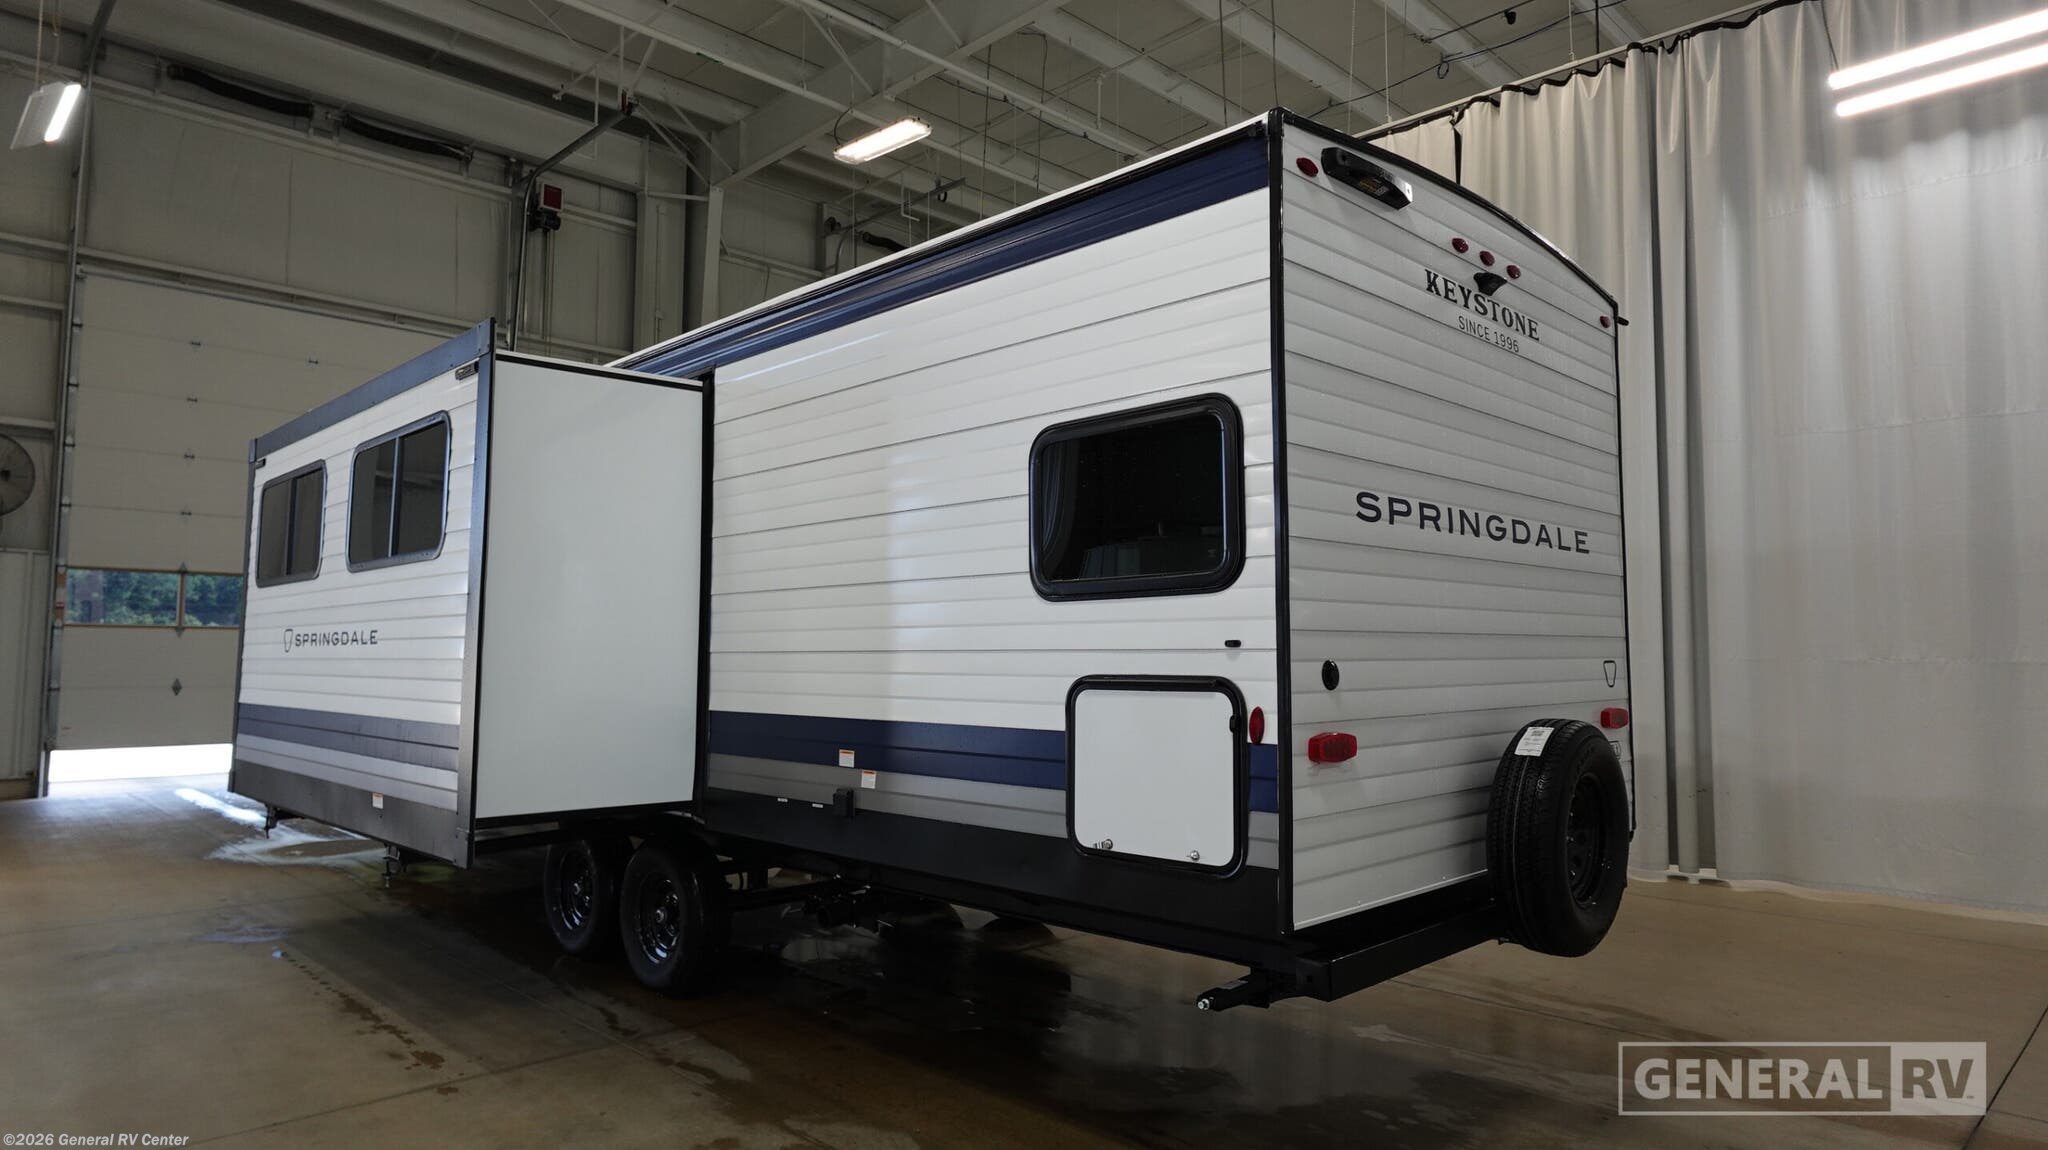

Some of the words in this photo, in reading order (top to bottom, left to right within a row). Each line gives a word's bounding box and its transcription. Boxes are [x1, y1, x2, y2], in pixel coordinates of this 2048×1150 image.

[1425, 269, 1540, 342] KEYSTONE
[1458, 315, 1491, 342] SINCE
[1494, 330, 1519, 353] 1996
[1355, 491, 1590, 555] SPRINGDALE
[294, 629, 379, 647] SPRINGDALE
